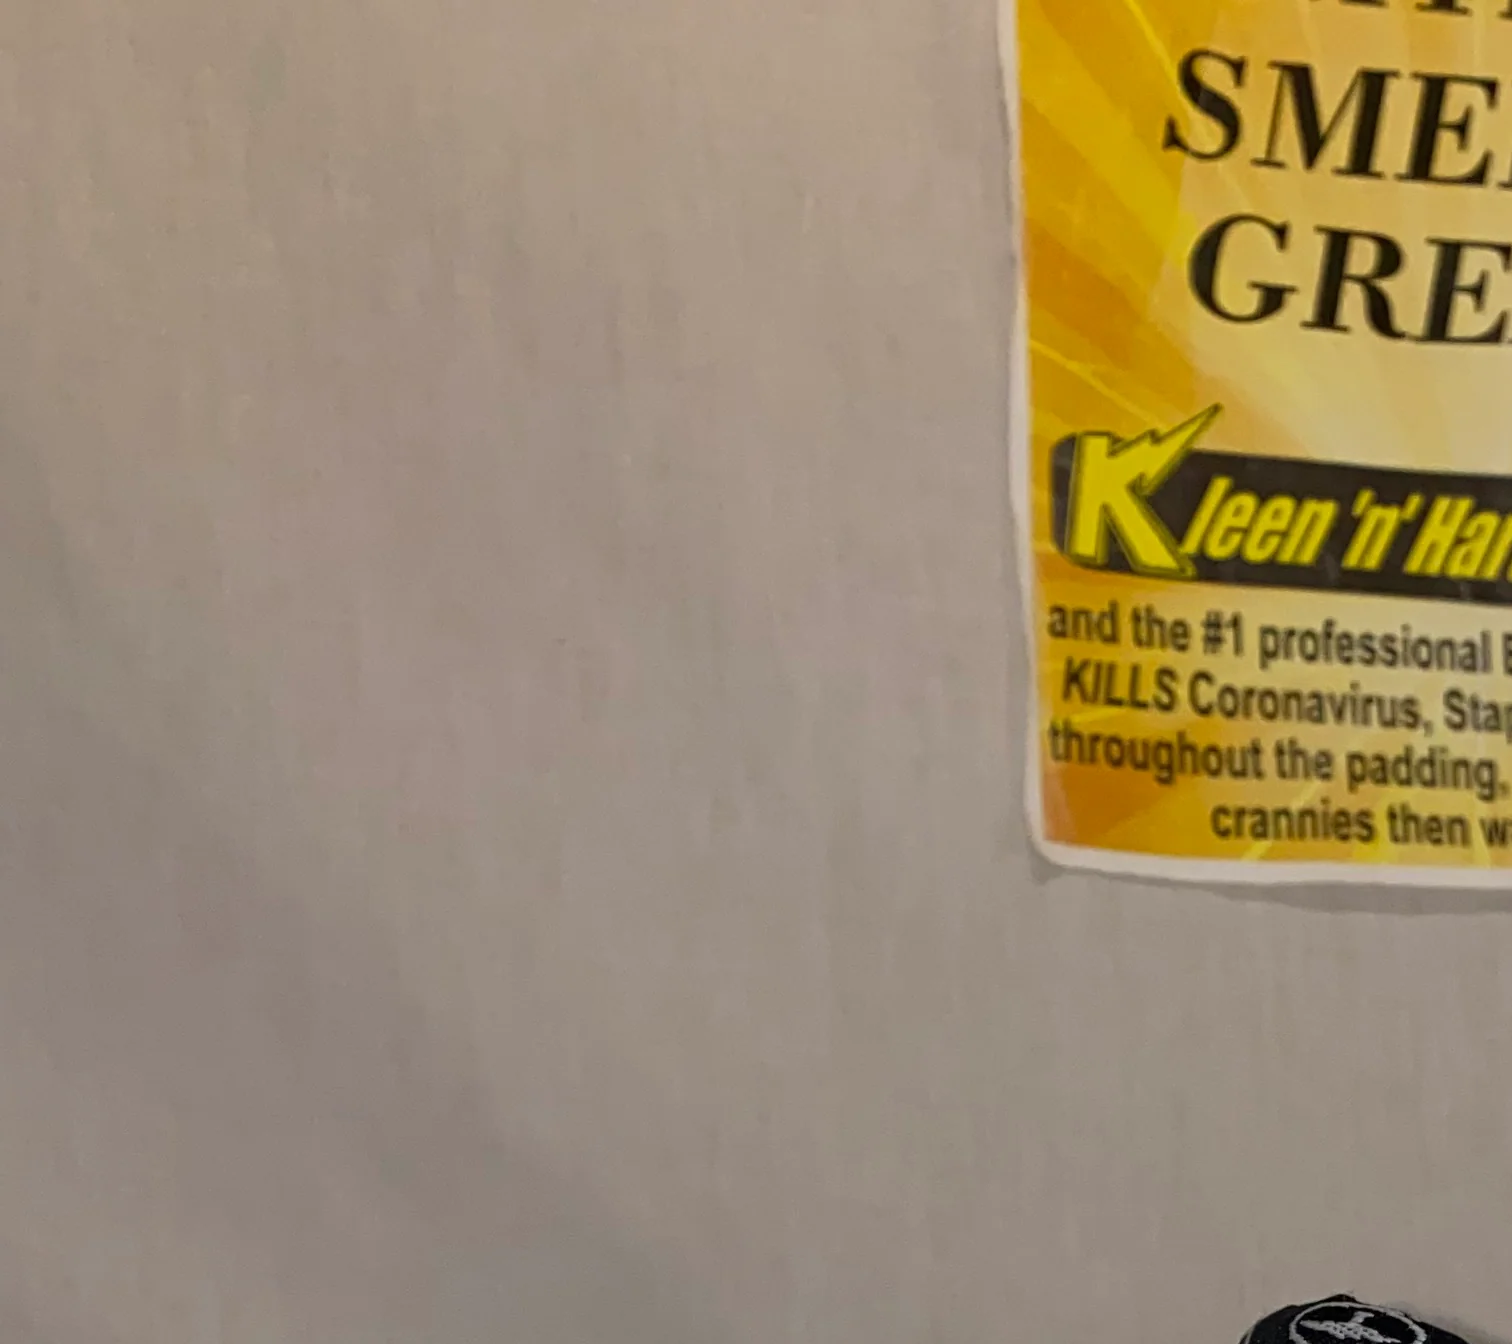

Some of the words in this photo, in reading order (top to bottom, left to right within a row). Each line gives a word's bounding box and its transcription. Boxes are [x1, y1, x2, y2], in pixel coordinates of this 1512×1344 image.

[1047, 600, 1120, 645] and
[1131, 603, 1191, 652] the
[1201, 608, 1244, 656] #1
[1259, 618, 1492, 674] professional
[1063, 656, 1178, 714] KILLS
[1188, 670, 1433, 737] Coronavirus,
[1049, 718, 1264, 785] throughout
[1275, 737, 1333, 782] the
[1210, 798, 1375, 844] crannies
[1387, 801, 1470, 846] then
